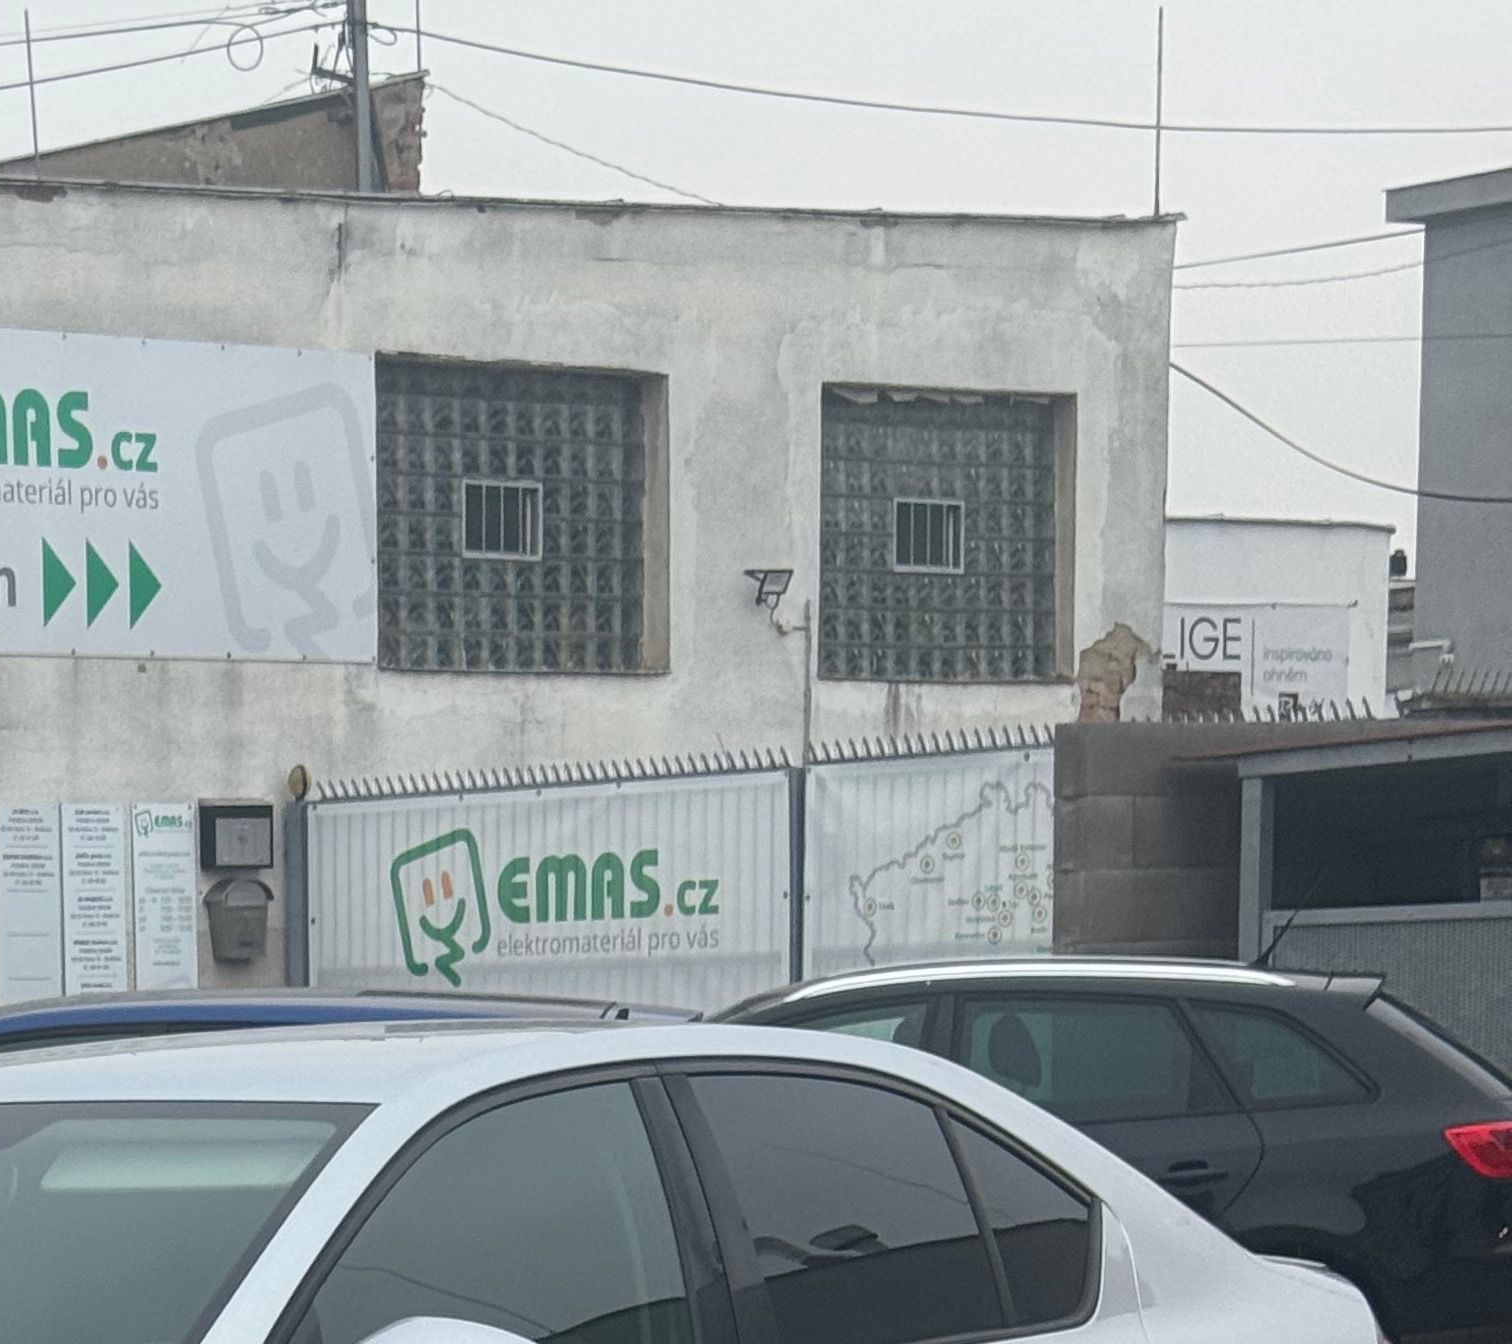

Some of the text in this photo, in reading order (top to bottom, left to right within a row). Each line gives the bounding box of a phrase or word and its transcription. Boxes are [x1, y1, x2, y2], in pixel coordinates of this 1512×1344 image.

[79, 486, 119, 512] pro
[123, 482, 159, 510] vás
[497, 848, 720, 924] EMAS.cz
[497, 925, 720, 957] elektromateriál pro vás
